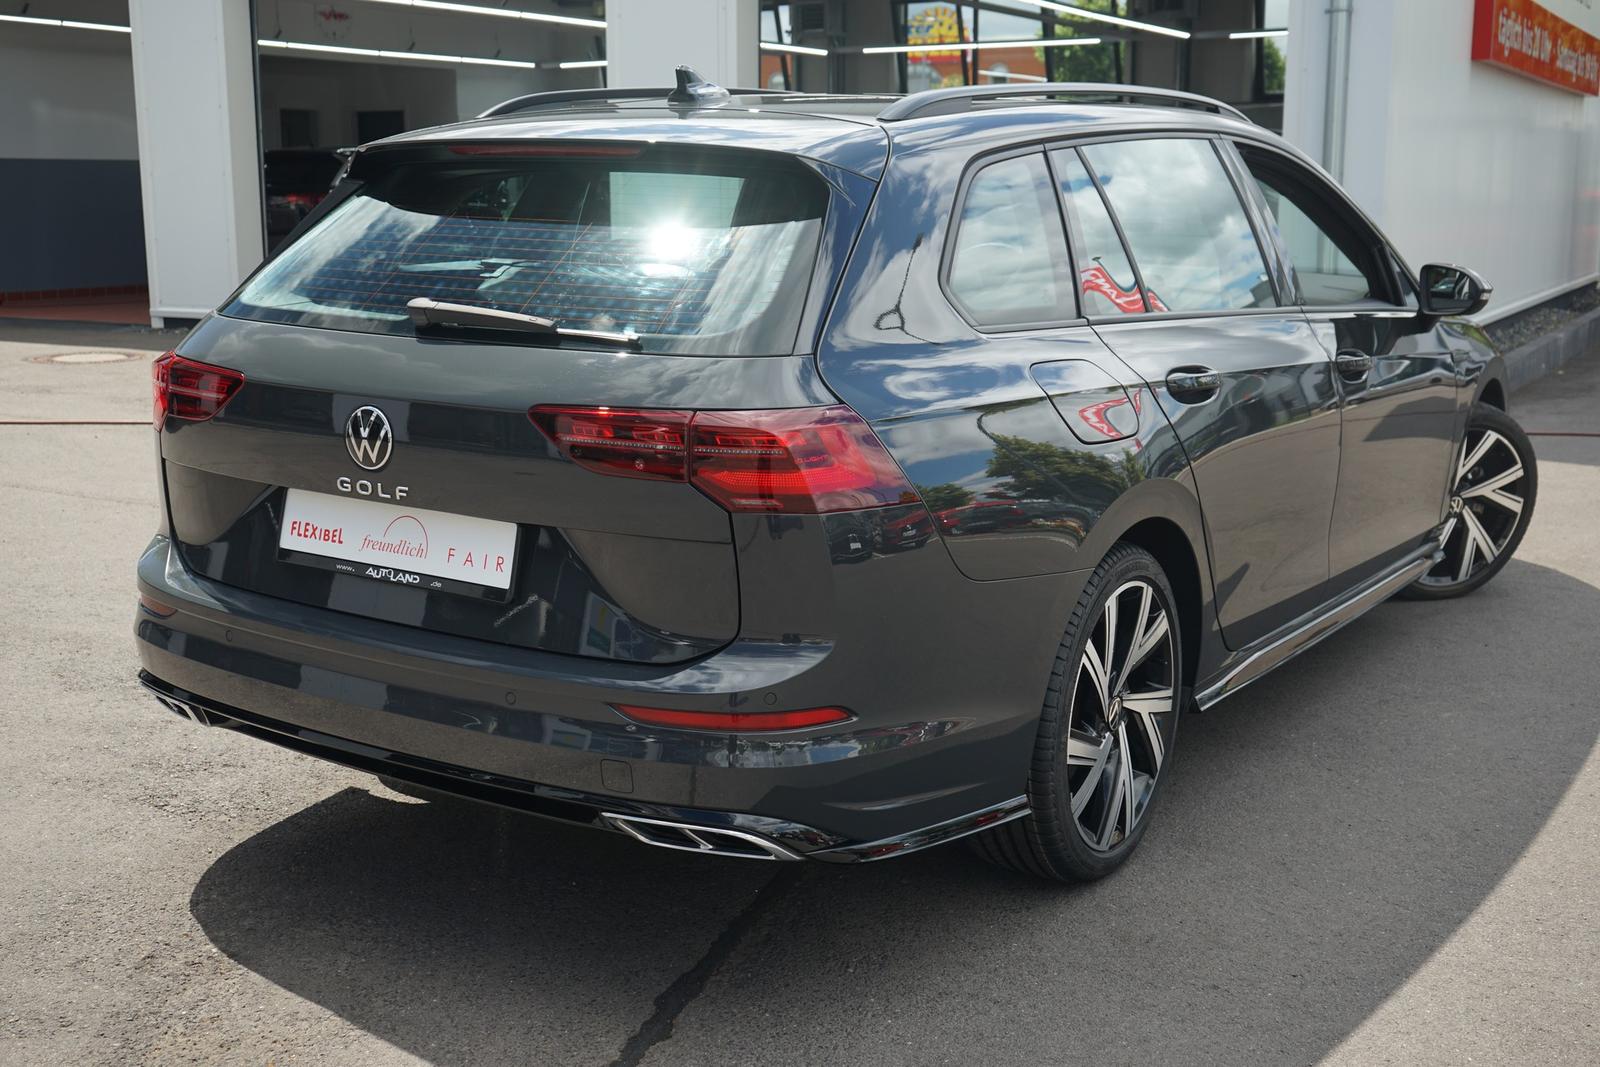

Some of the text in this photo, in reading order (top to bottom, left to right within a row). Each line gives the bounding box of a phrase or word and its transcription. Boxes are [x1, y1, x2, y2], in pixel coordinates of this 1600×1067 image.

[336, 476, 409, 500] GOLF
[290, 520, 505, 573] FLEXIBEL freundlich FAIR
[365, 567, 420, 584] AUTOLAND
